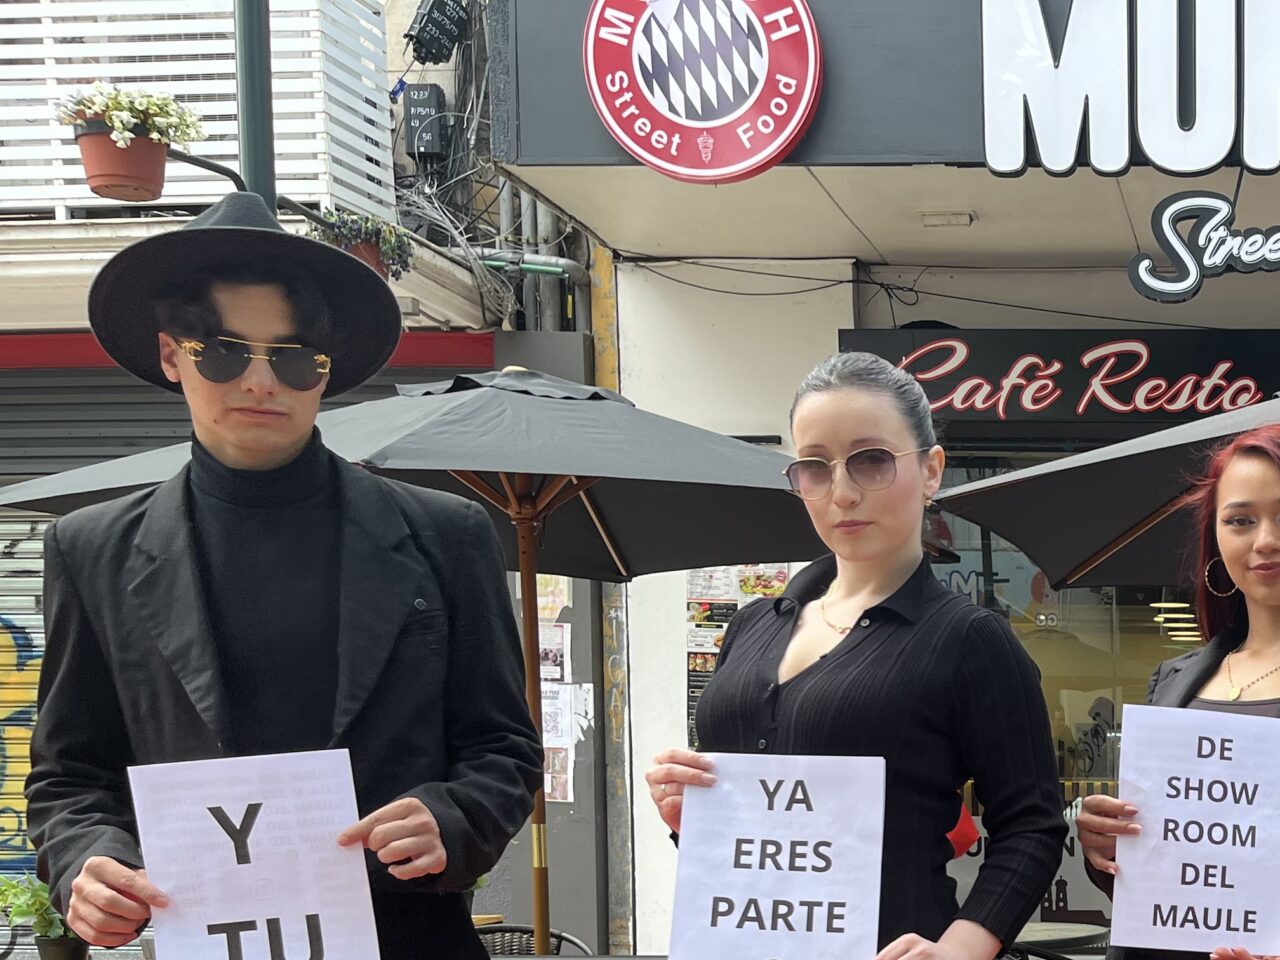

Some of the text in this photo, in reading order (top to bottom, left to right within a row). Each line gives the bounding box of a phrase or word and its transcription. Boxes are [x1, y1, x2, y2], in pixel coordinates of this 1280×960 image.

[605, 70, 798, 157] Street Food
[1075, 338, 1263, 415] Resto
[1196, 736, 1234, 761] DE
[758, 779, 814, 812] YA
[1165, 776, 1259, 805] SHOW
[206, 803, 263, 865] Y
[1162, 818, 1257, 848] ROOM
[733, 838, 833, 873] ERES
[1180, 862, 1235, 889] DEL
[710, 896, 847, 934] PARTE
[1152, 903, 1257, 933] MAULE
